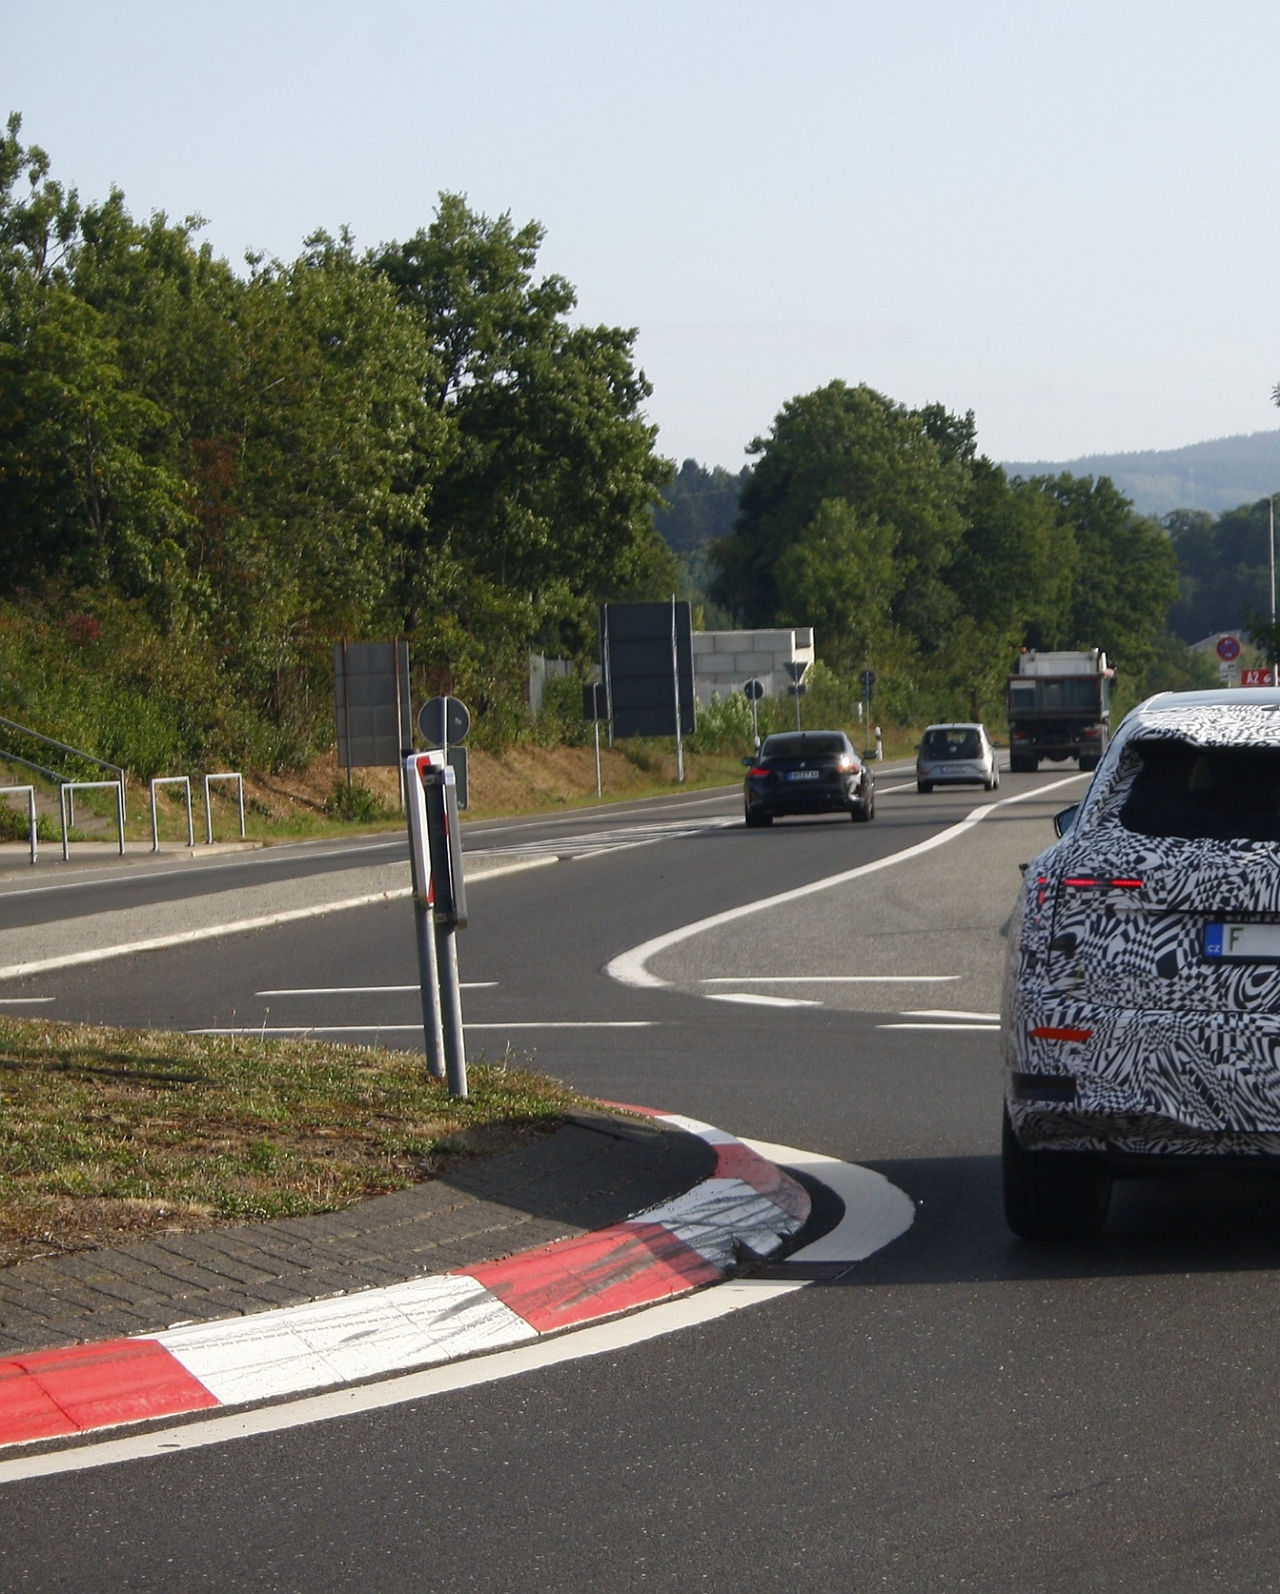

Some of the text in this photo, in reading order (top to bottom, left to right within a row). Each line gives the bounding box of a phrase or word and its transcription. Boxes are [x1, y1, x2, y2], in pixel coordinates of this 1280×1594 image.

[1247, 671, 1260, 684] A2
[1229, 927, 1243, 953] F
[1207, 945, 1220, 953] CZ
